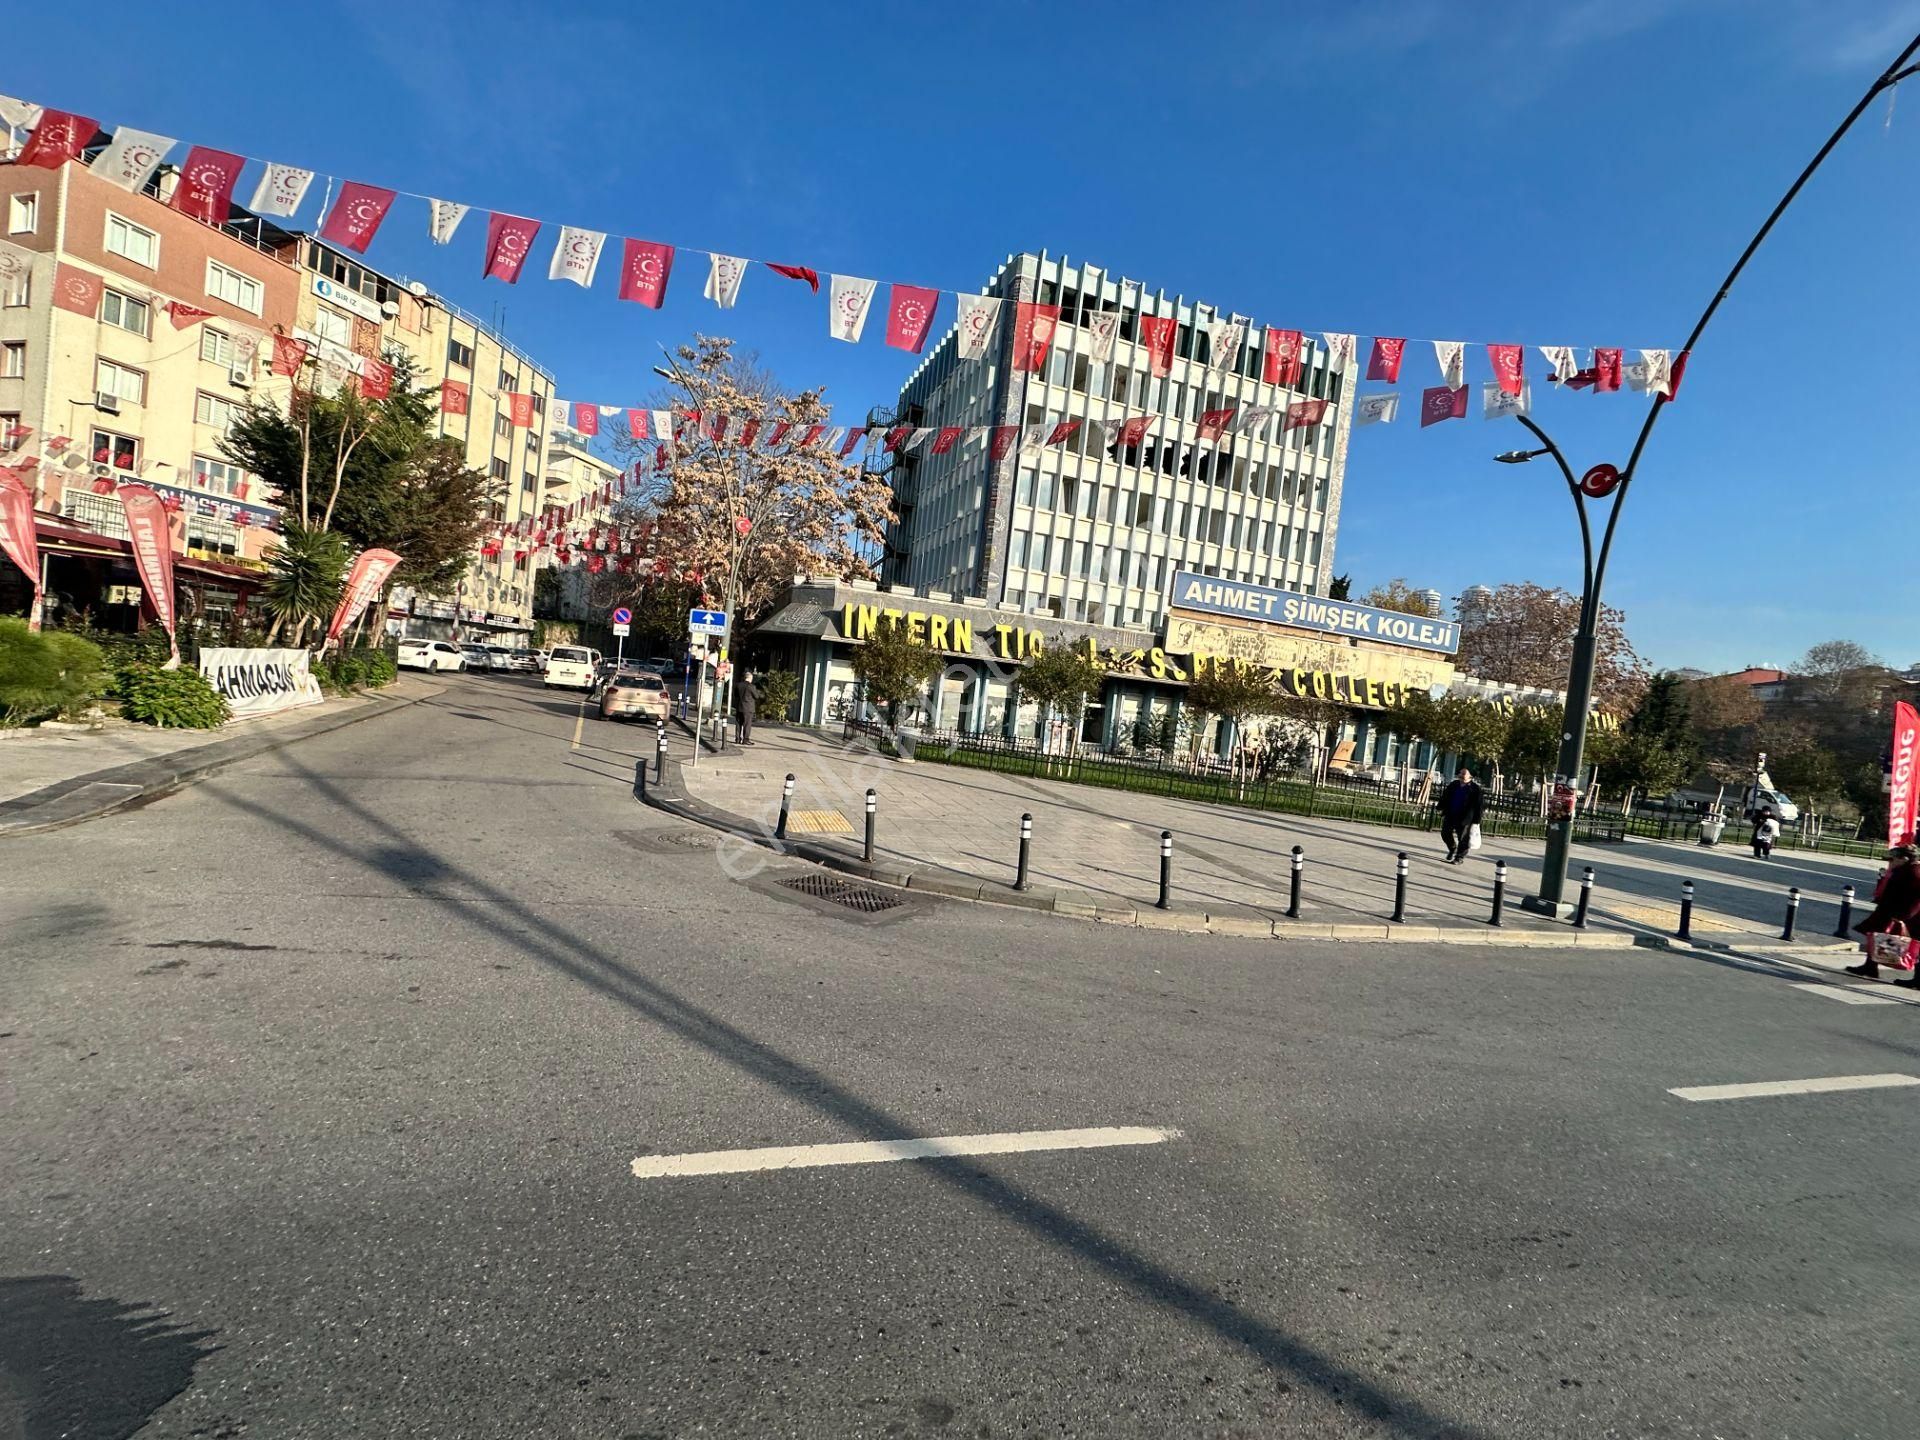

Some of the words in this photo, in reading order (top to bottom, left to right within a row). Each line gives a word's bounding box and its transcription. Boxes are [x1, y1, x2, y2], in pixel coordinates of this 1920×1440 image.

[497, 255, 518, 268] BTP
[566, 260, 585, 271] BTP
[636, 280, 655, 291] BTP
[901, 327, 919, 338] BTP
[1183, 580, 1278, 615] AHMET
[1283, 594, 1372, 634] ŞİMŞEK
[1376, 615, 1452, 647] KOLEJİ
